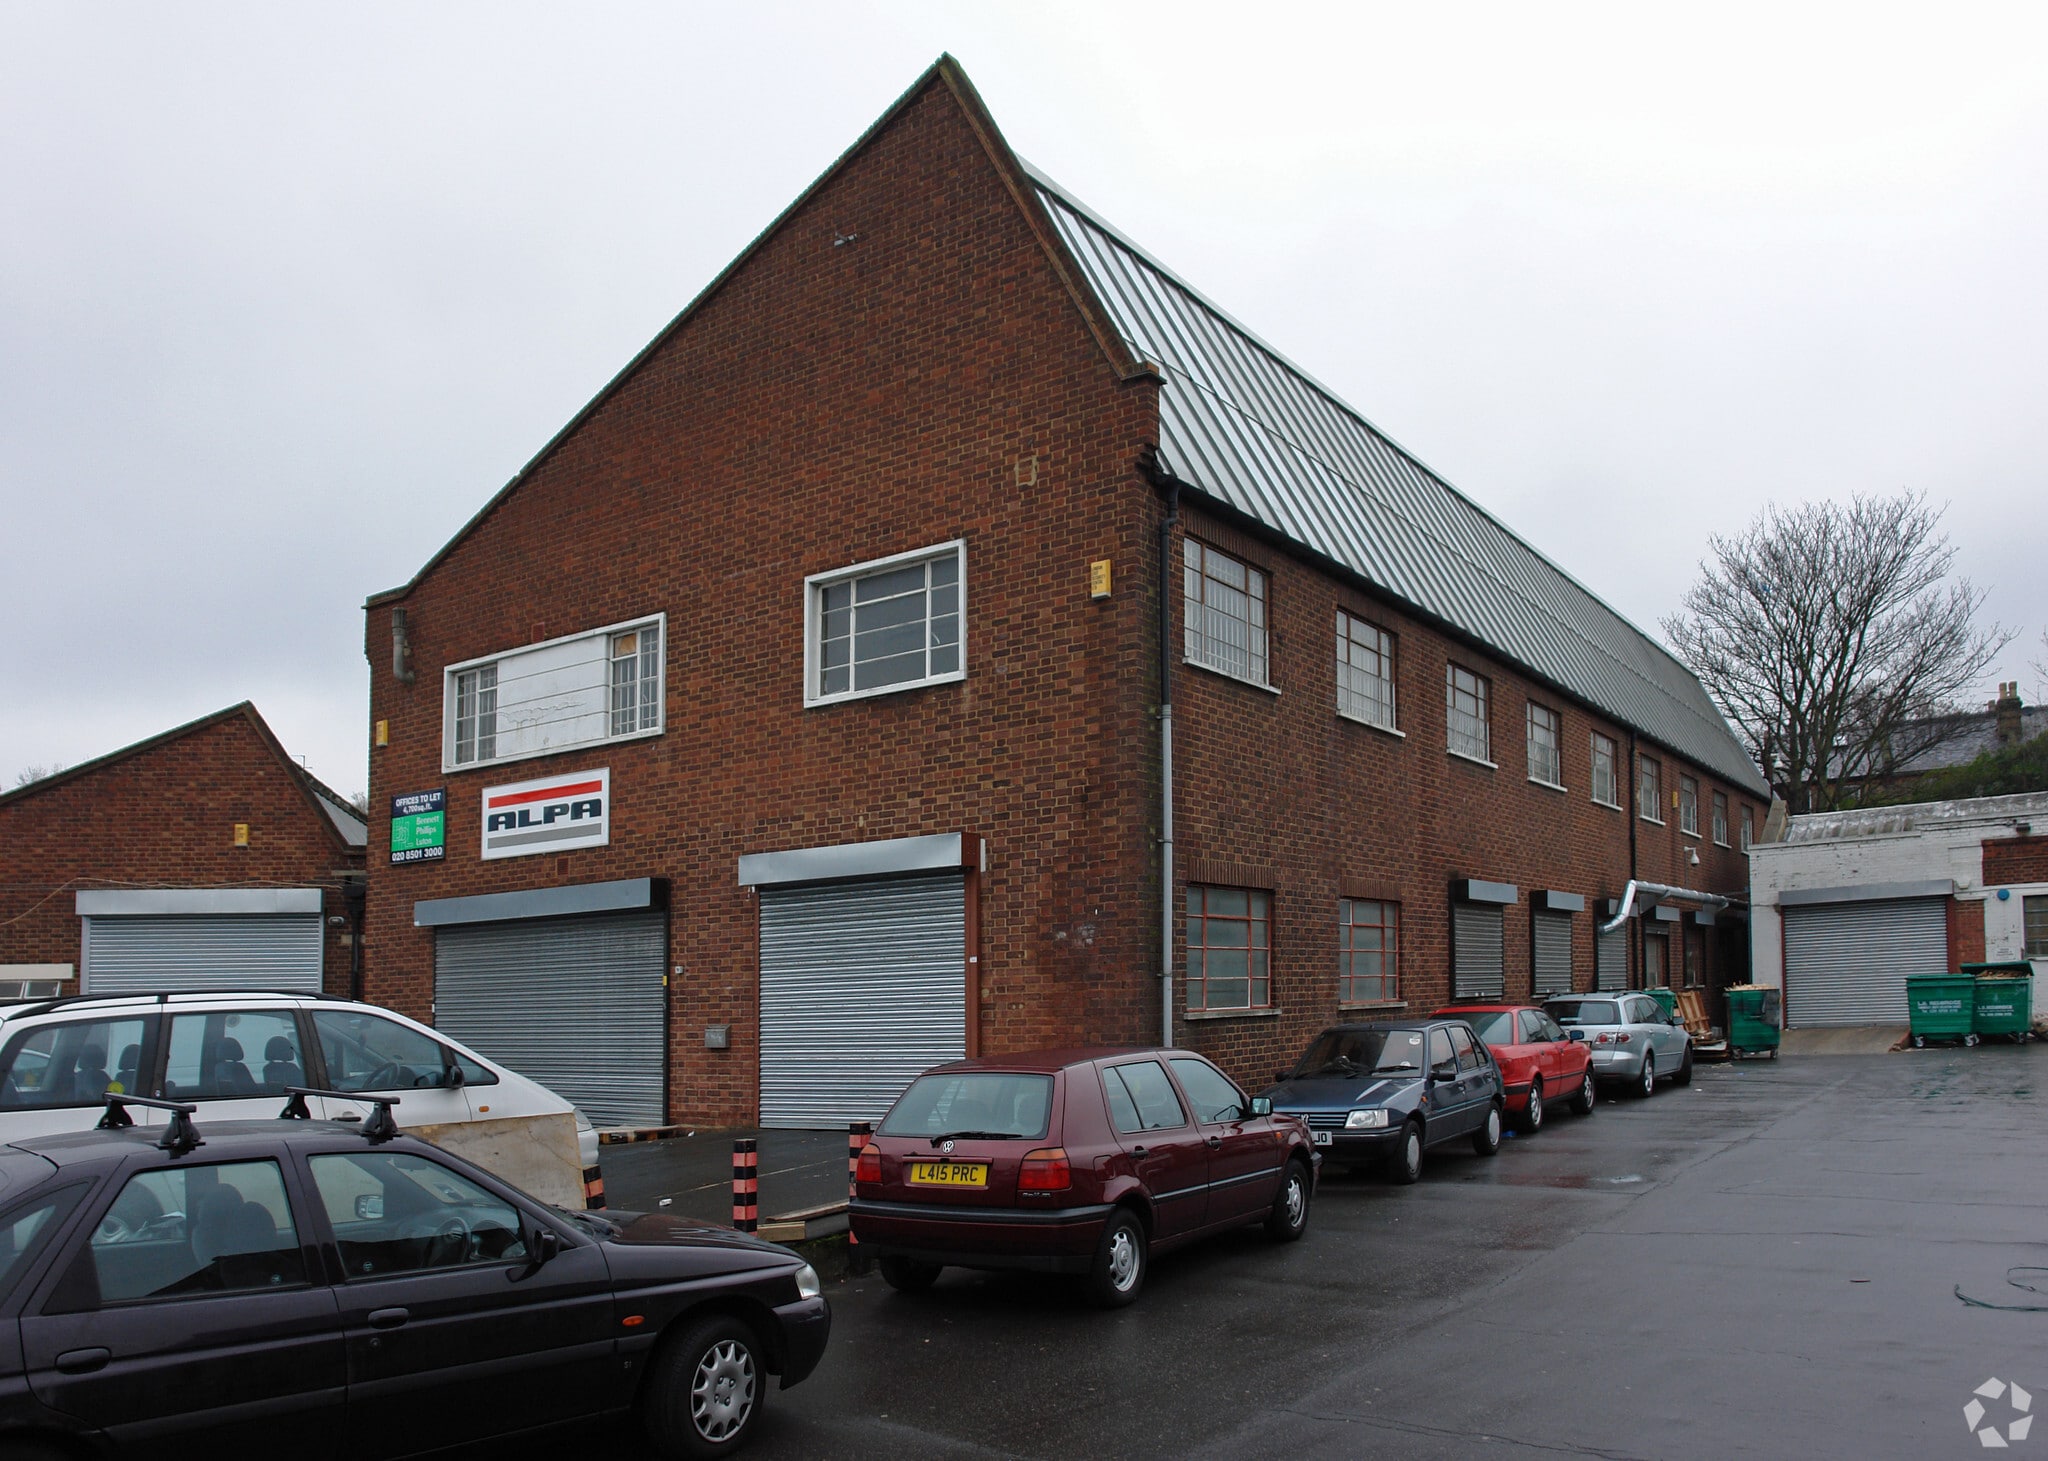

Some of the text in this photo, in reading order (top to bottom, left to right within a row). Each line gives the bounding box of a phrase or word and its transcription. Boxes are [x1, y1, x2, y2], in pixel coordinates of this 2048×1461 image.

[395, 792, 441, 807] OFFICES TO LET
[416, 815, 440, 825] Bennett
[487, 798, 602, 832] ALPA
[416, 838, 432, 846] Luton
[392, 846, 443, 861] 020 8501 3000
[918, 1164, 979, 1182] L415 PRC
